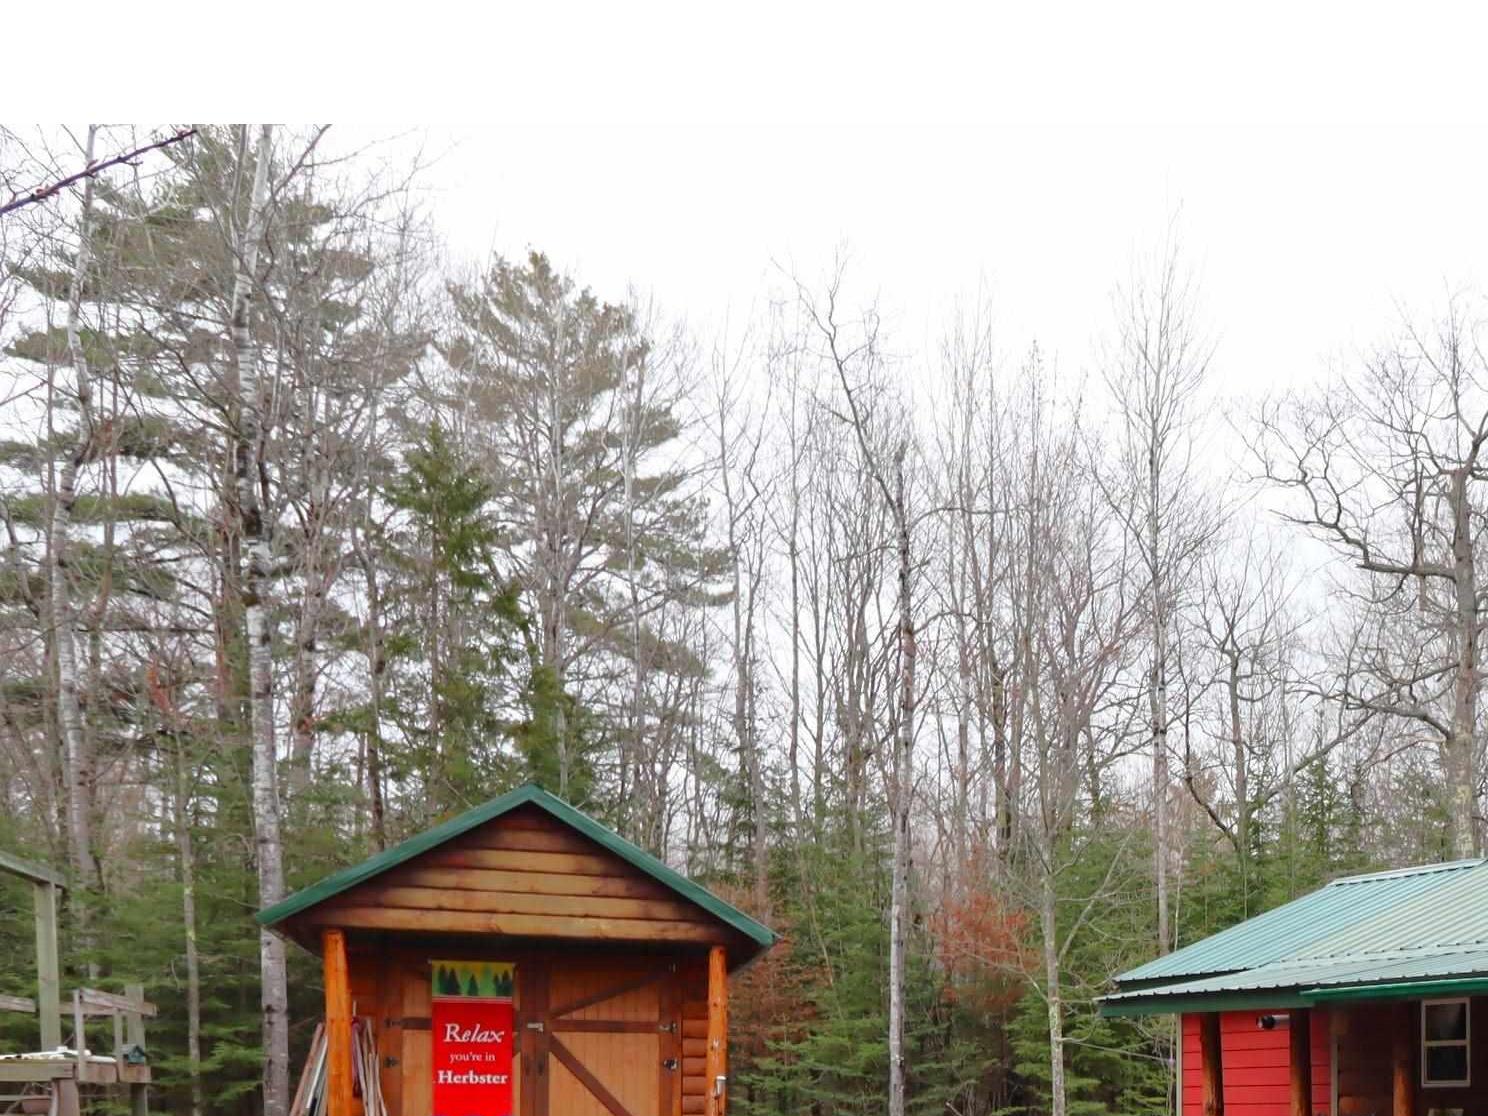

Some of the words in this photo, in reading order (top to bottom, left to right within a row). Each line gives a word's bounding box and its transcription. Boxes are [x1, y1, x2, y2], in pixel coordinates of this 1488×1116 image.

[443, 1023, 505, 1043] Relax
[449, 1051, 482, 1063] you're
[485, 1051, 496, 1061] in
[438, 1069, 508, 1084] Herbster
